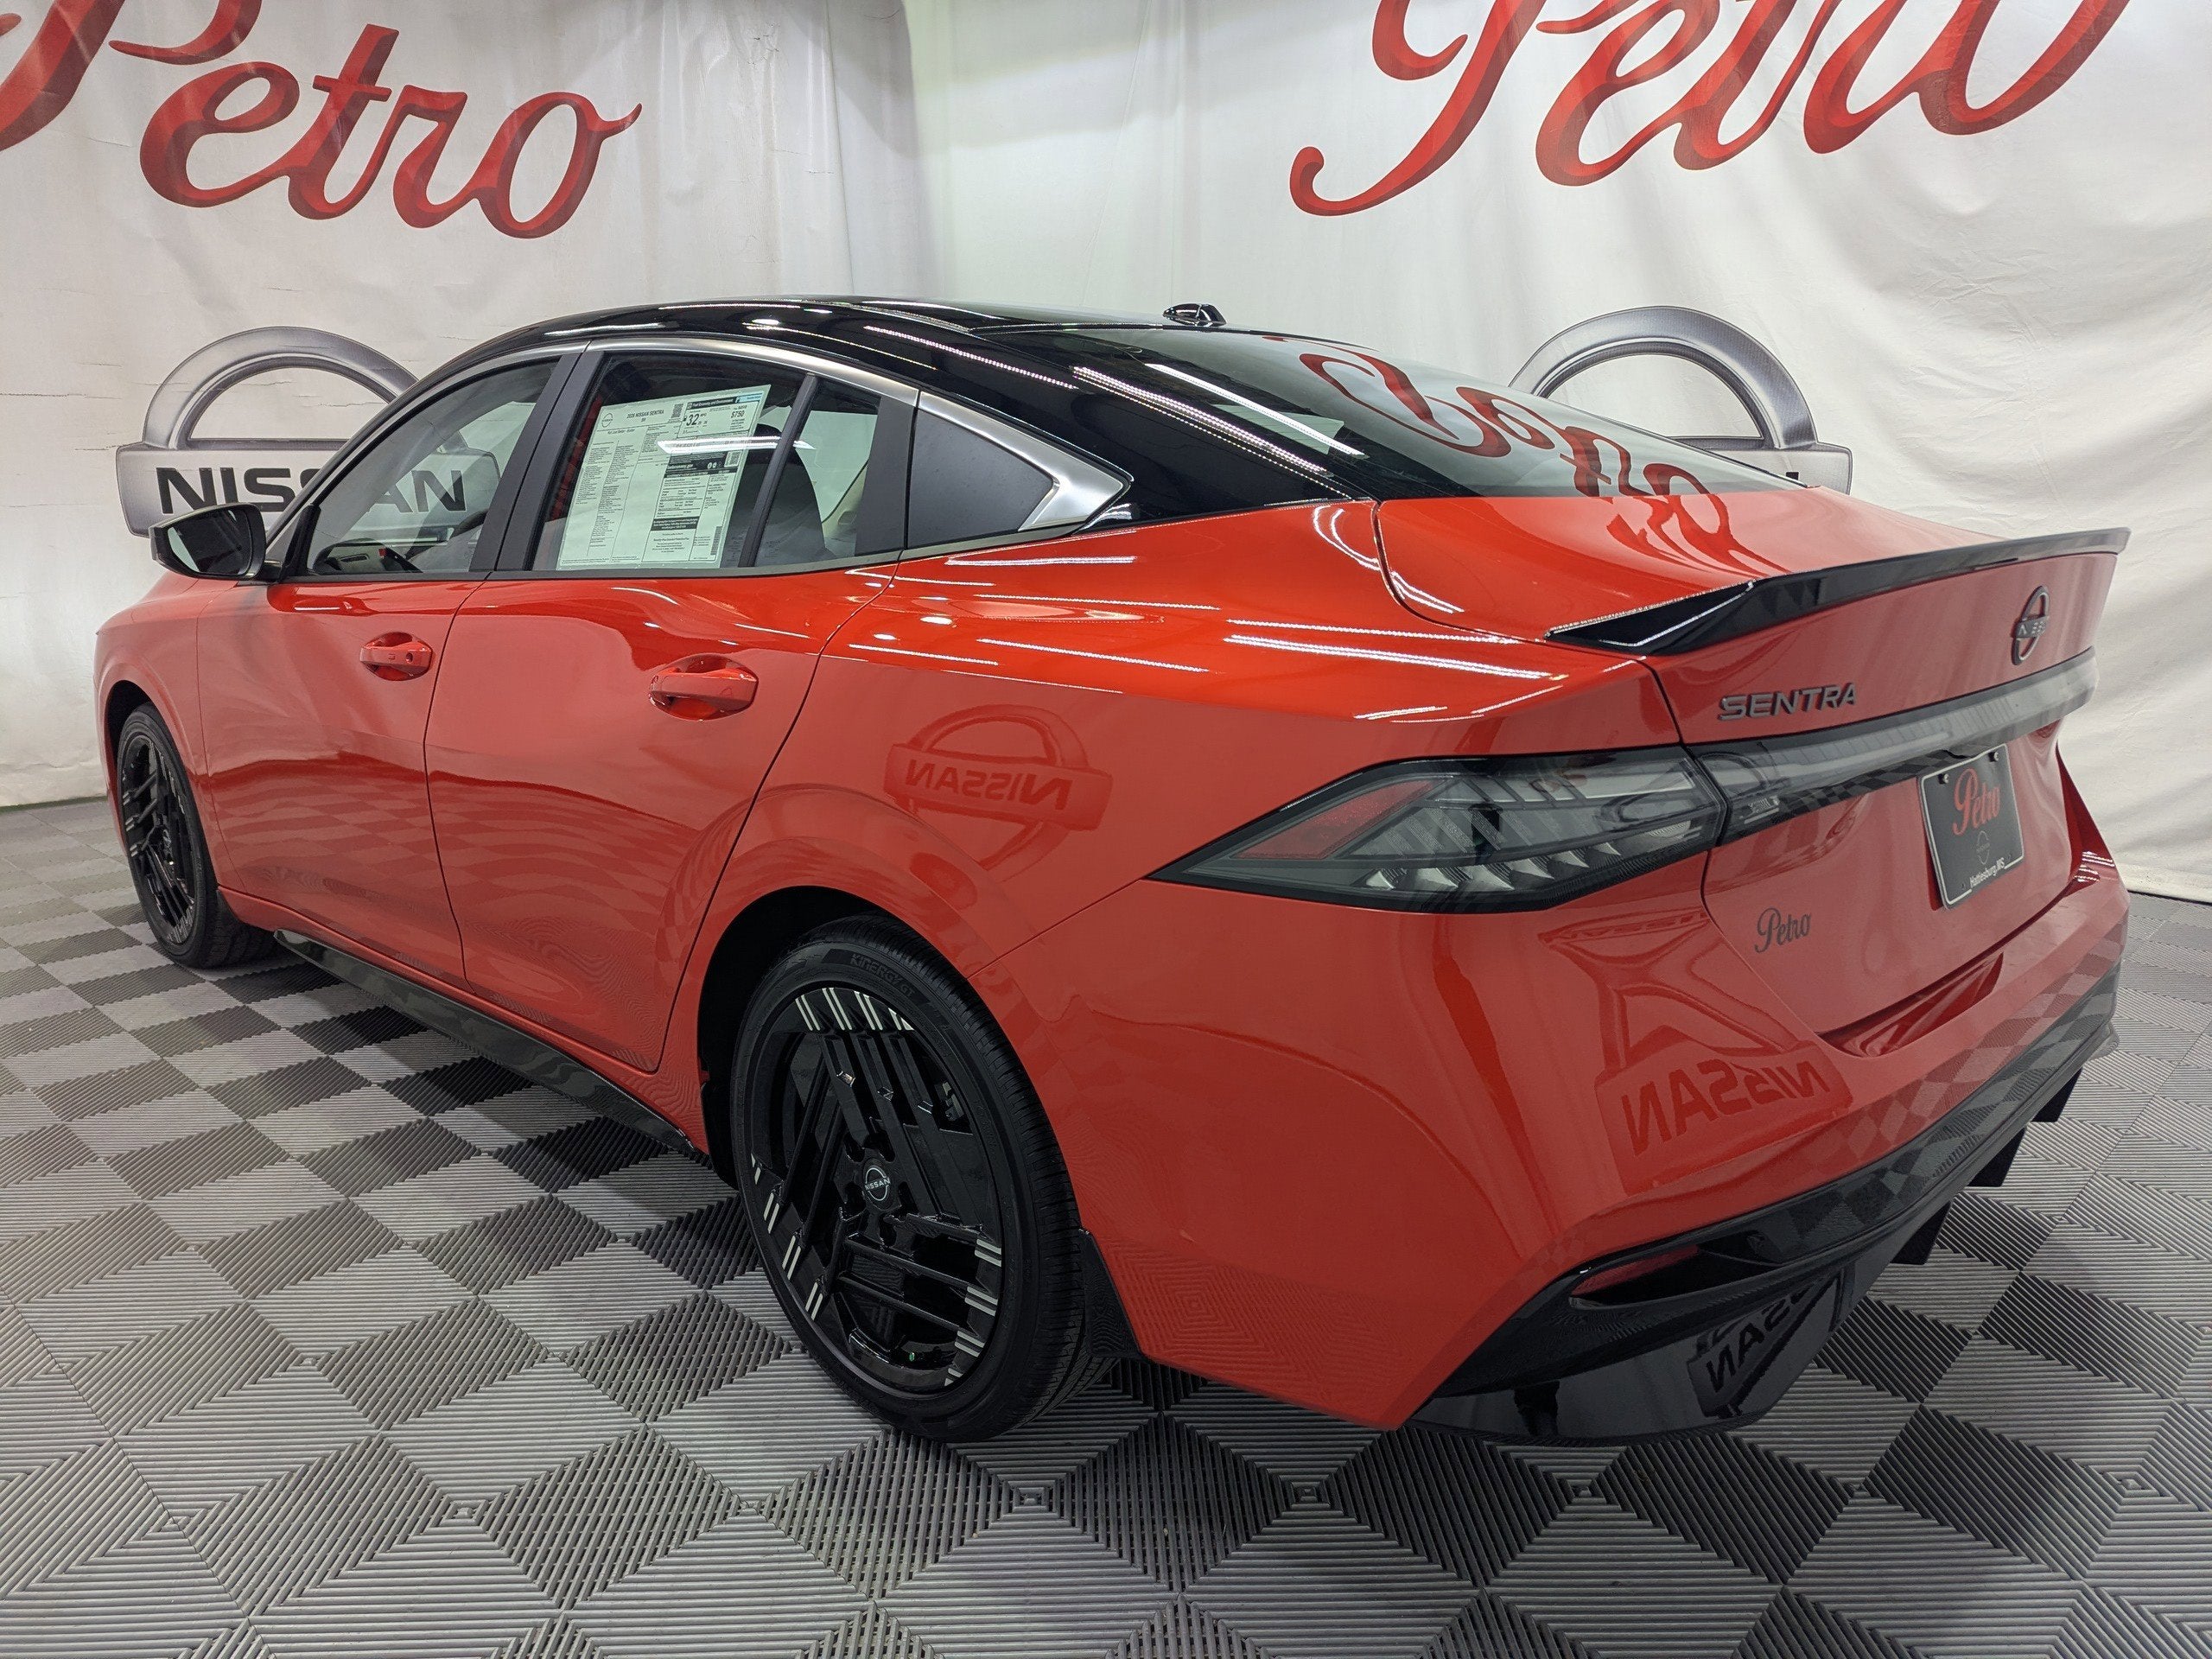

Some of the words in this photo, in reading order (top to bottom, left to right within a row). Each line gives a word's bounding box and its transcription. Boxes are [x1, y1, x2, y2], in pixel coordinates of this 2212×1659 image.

[686, 413, 700, 426] 32
[156, 467, 466, 514] NISAN
[1717, 682, 1856, 721] SENTRA
[1953, 768, 2000, 836] Petro
[1754, 907, 1811, 953] Petro
